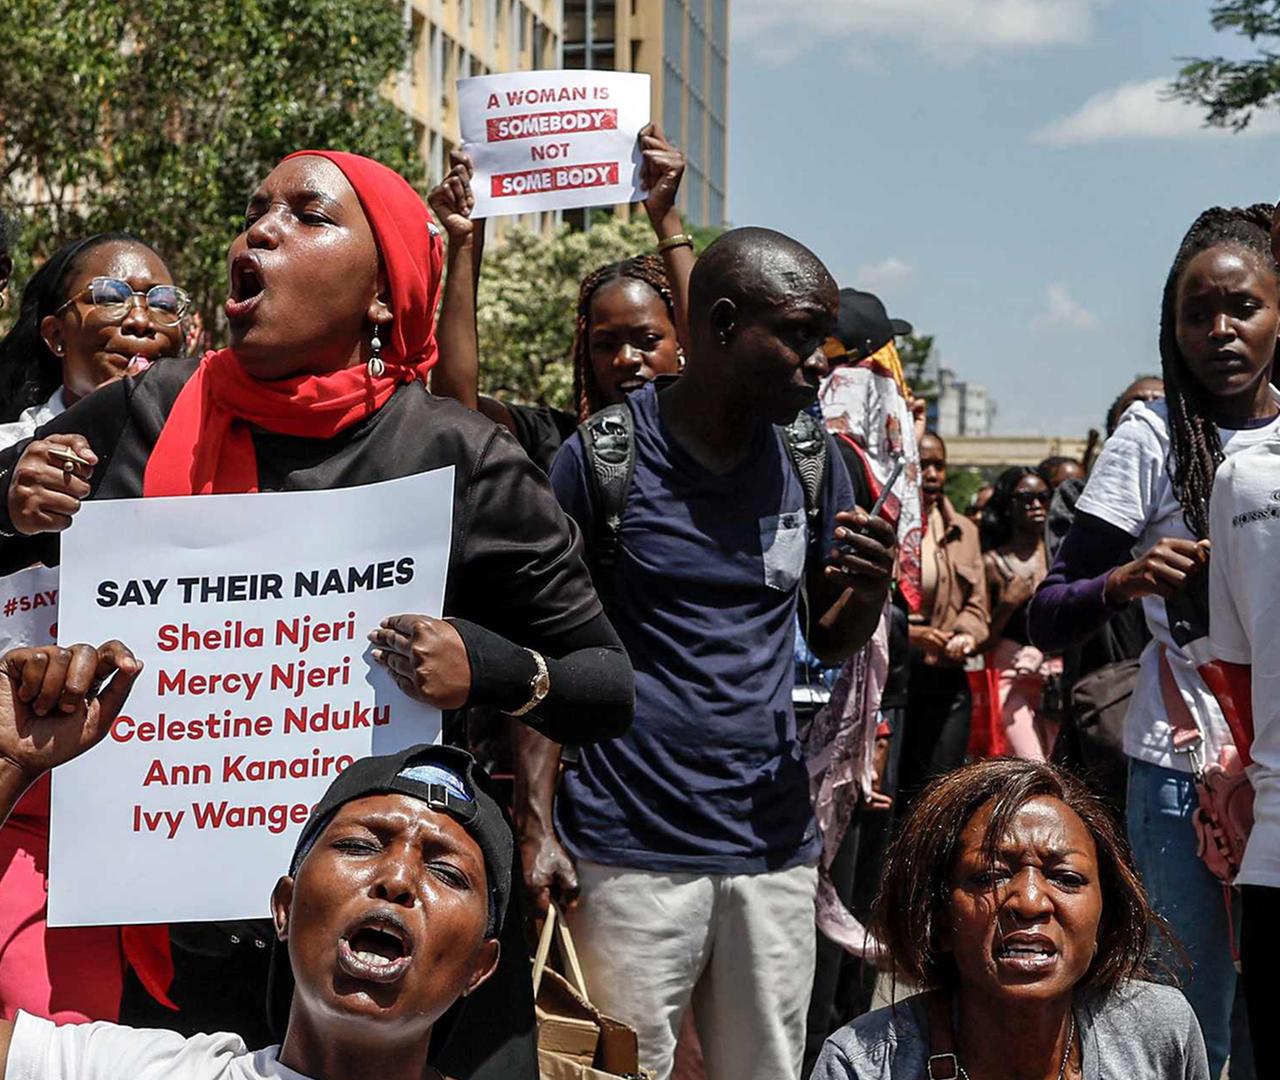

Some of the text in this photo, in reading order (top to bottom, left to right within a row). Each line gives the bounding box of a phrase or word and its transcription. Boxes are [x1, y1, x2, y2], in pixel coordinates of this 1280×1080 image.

[487, 87, 610, 109] A WOMAN IS
[498, 111, 606, 137] SOMEBODY
[530, 143, 570, 161] NOT
[502, 166, 611, 194] SOME BODY
[96, 557, 415, 607] SAY THEIR NAMES
[156, 611, 356, 653] Sheila Njeri
[157, 656, 351, 701] Mercy Njeri
[109, 700, 391, 744] Celestine Nduku
[142, 748, 355, 787] Ann Kanairo
[132, 804, 186, 839] Ivy
